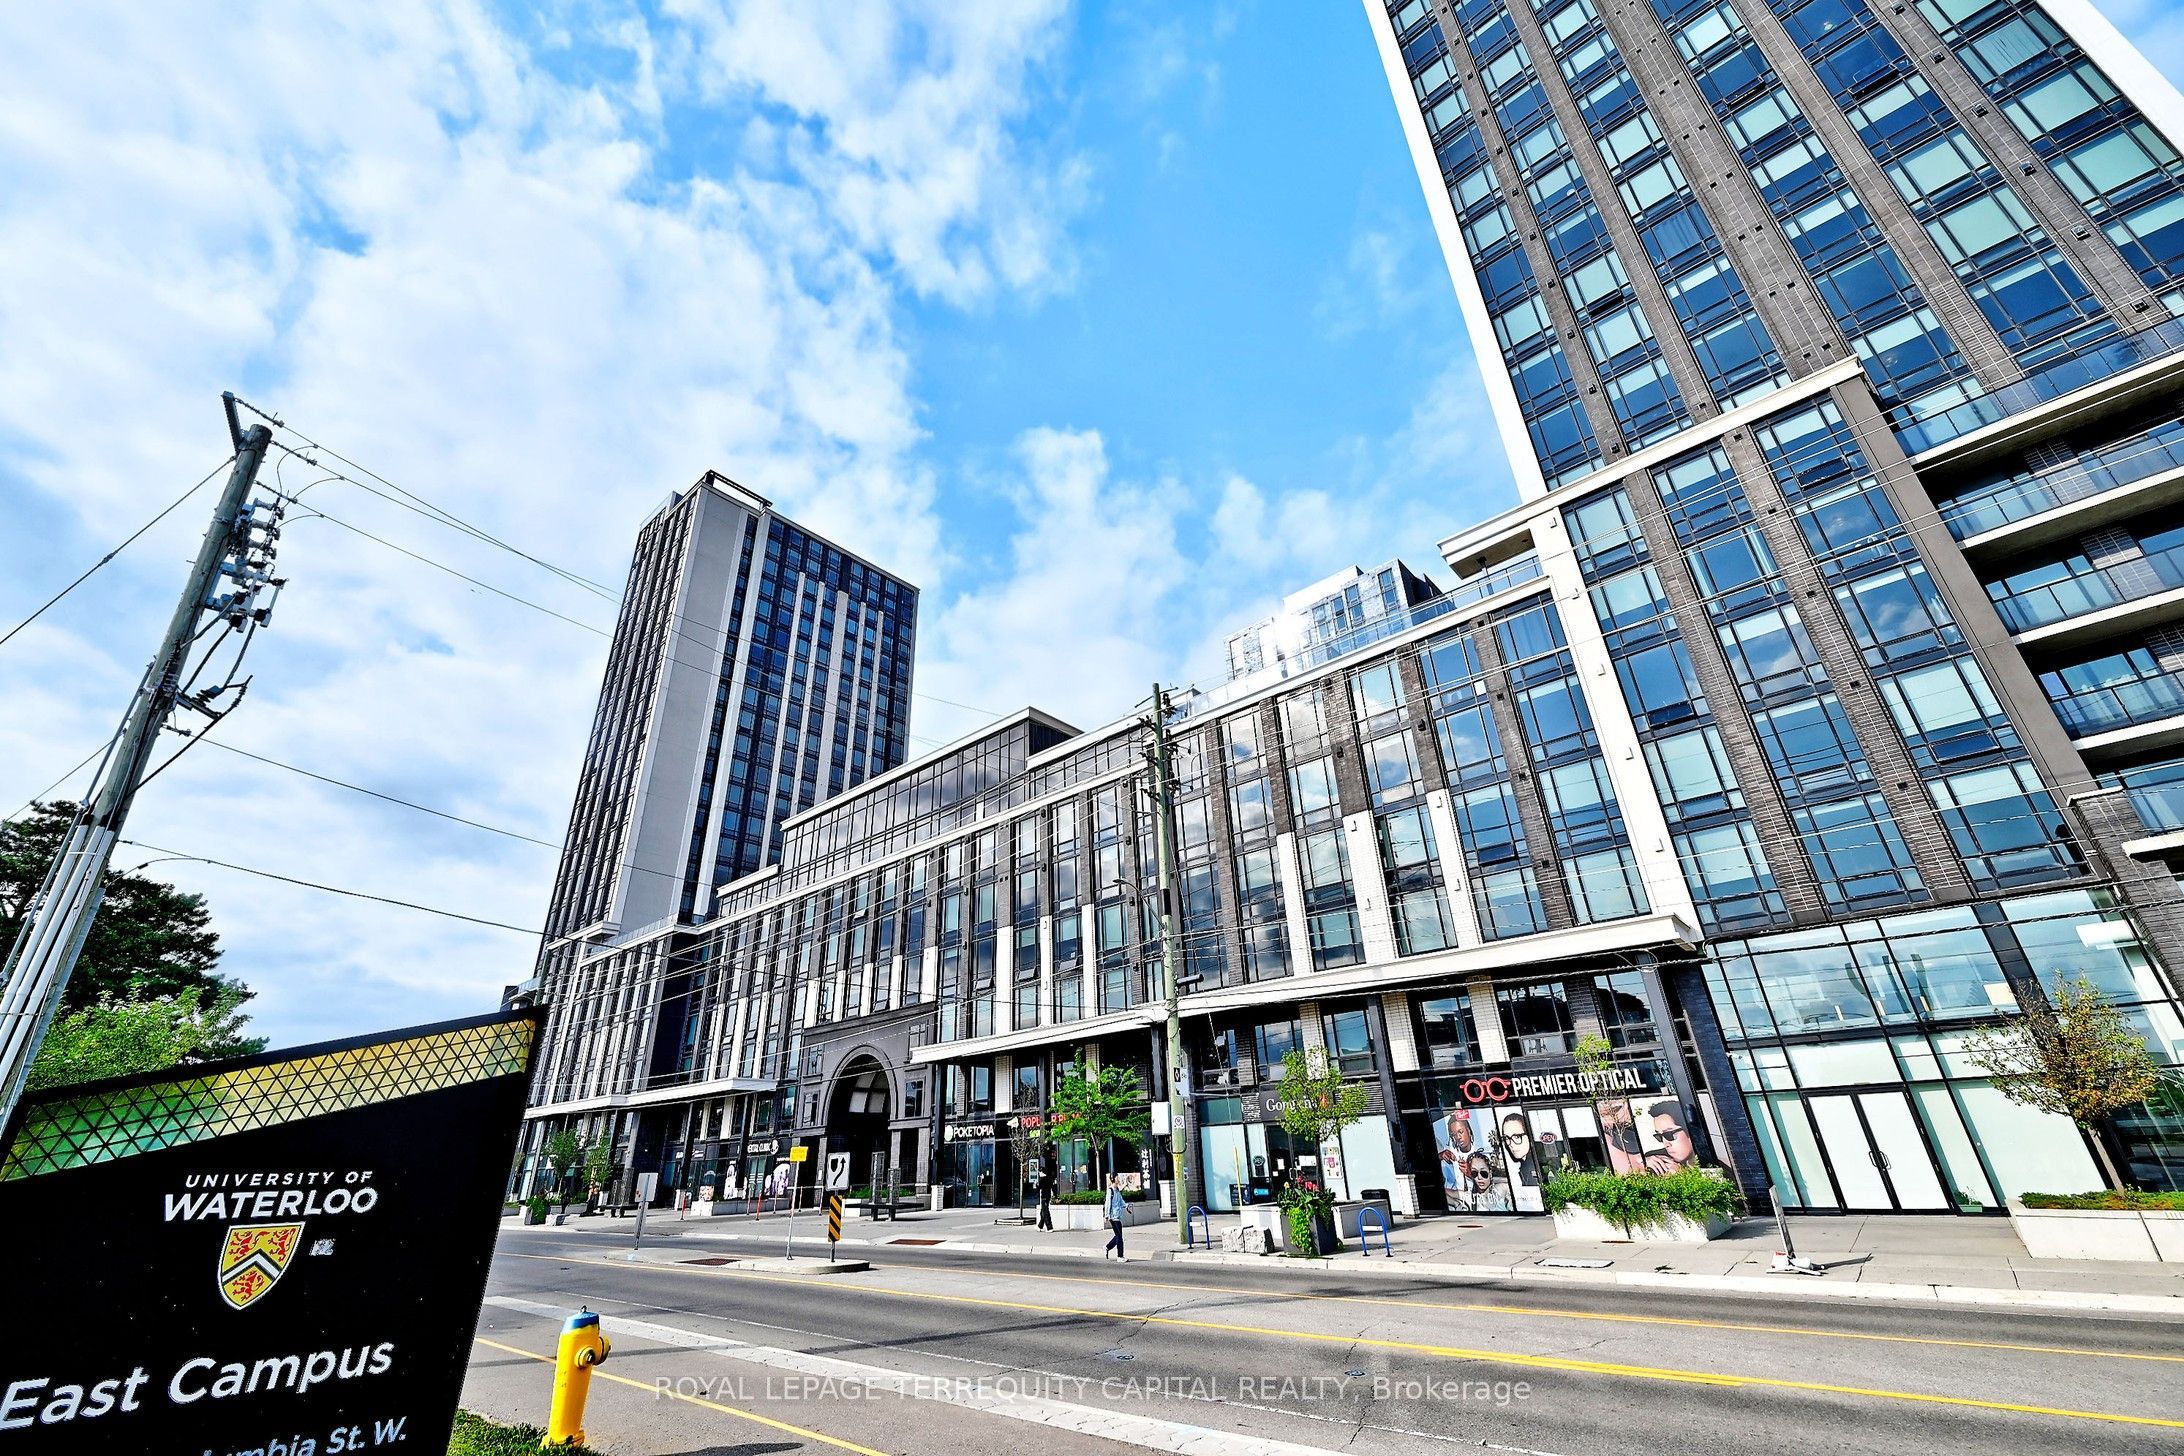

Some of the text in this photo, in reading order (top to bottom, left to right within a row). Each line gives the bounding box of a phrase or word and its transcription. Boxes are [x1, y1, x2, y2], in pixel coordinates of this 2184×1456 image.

[1512, 1073, 1580, 1098] PREMIER
[1578, 1067, 1646, 1091] OPTICAL
[953, 1124, 995, 1138] POKETOPIA
[185, 1170, 373, 1188] UNIVERSITY OF
[164, 1187, 378, 1222] WATERLOO
[0, 1341, 395, 1431] East Campus
[326, 1426, 366, 1454] St.
[374, 1416, 407, 1446] W.
